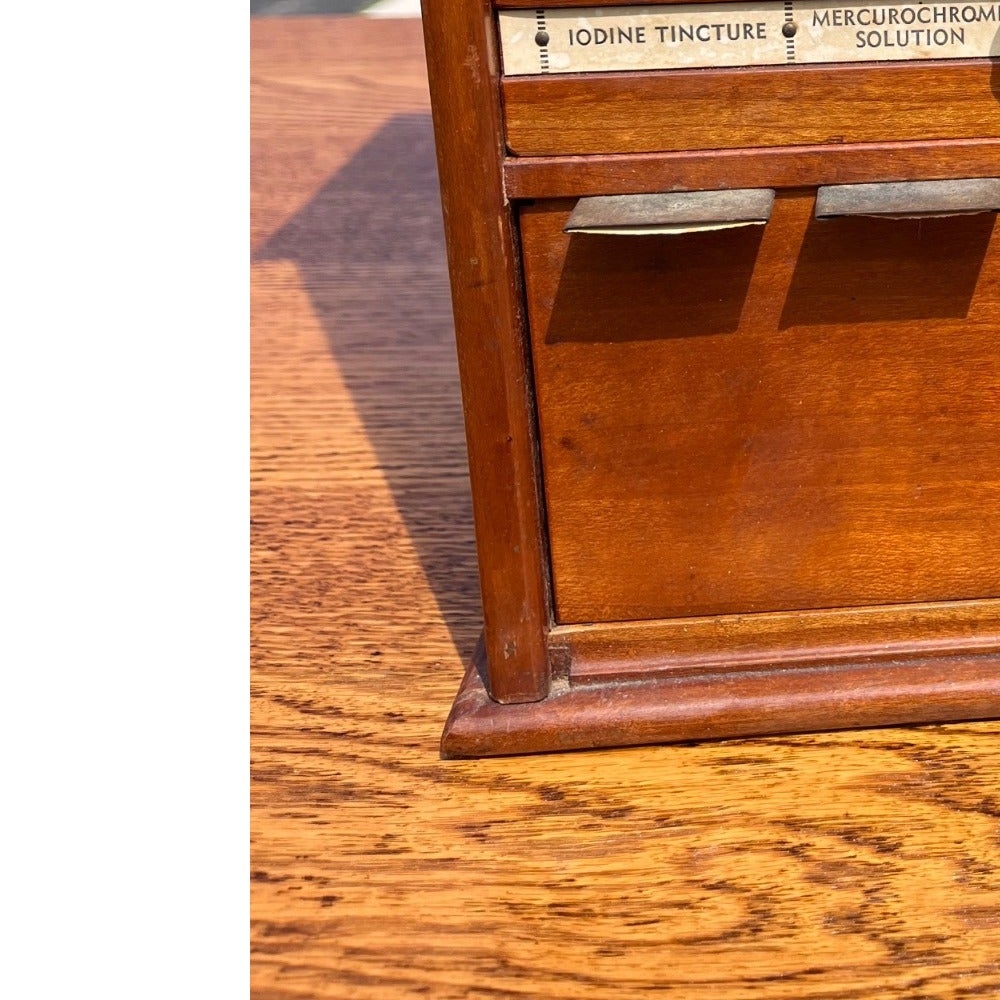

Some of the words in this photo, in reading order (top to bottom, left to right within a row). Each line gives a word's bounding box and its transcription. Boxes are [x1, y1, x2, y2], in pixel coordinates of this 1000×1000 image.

[568, 26, 646, 46] IODINE
[655, 22, 767, 45] TINCTURE
[855, 27, 966, 49] SOLUTION
